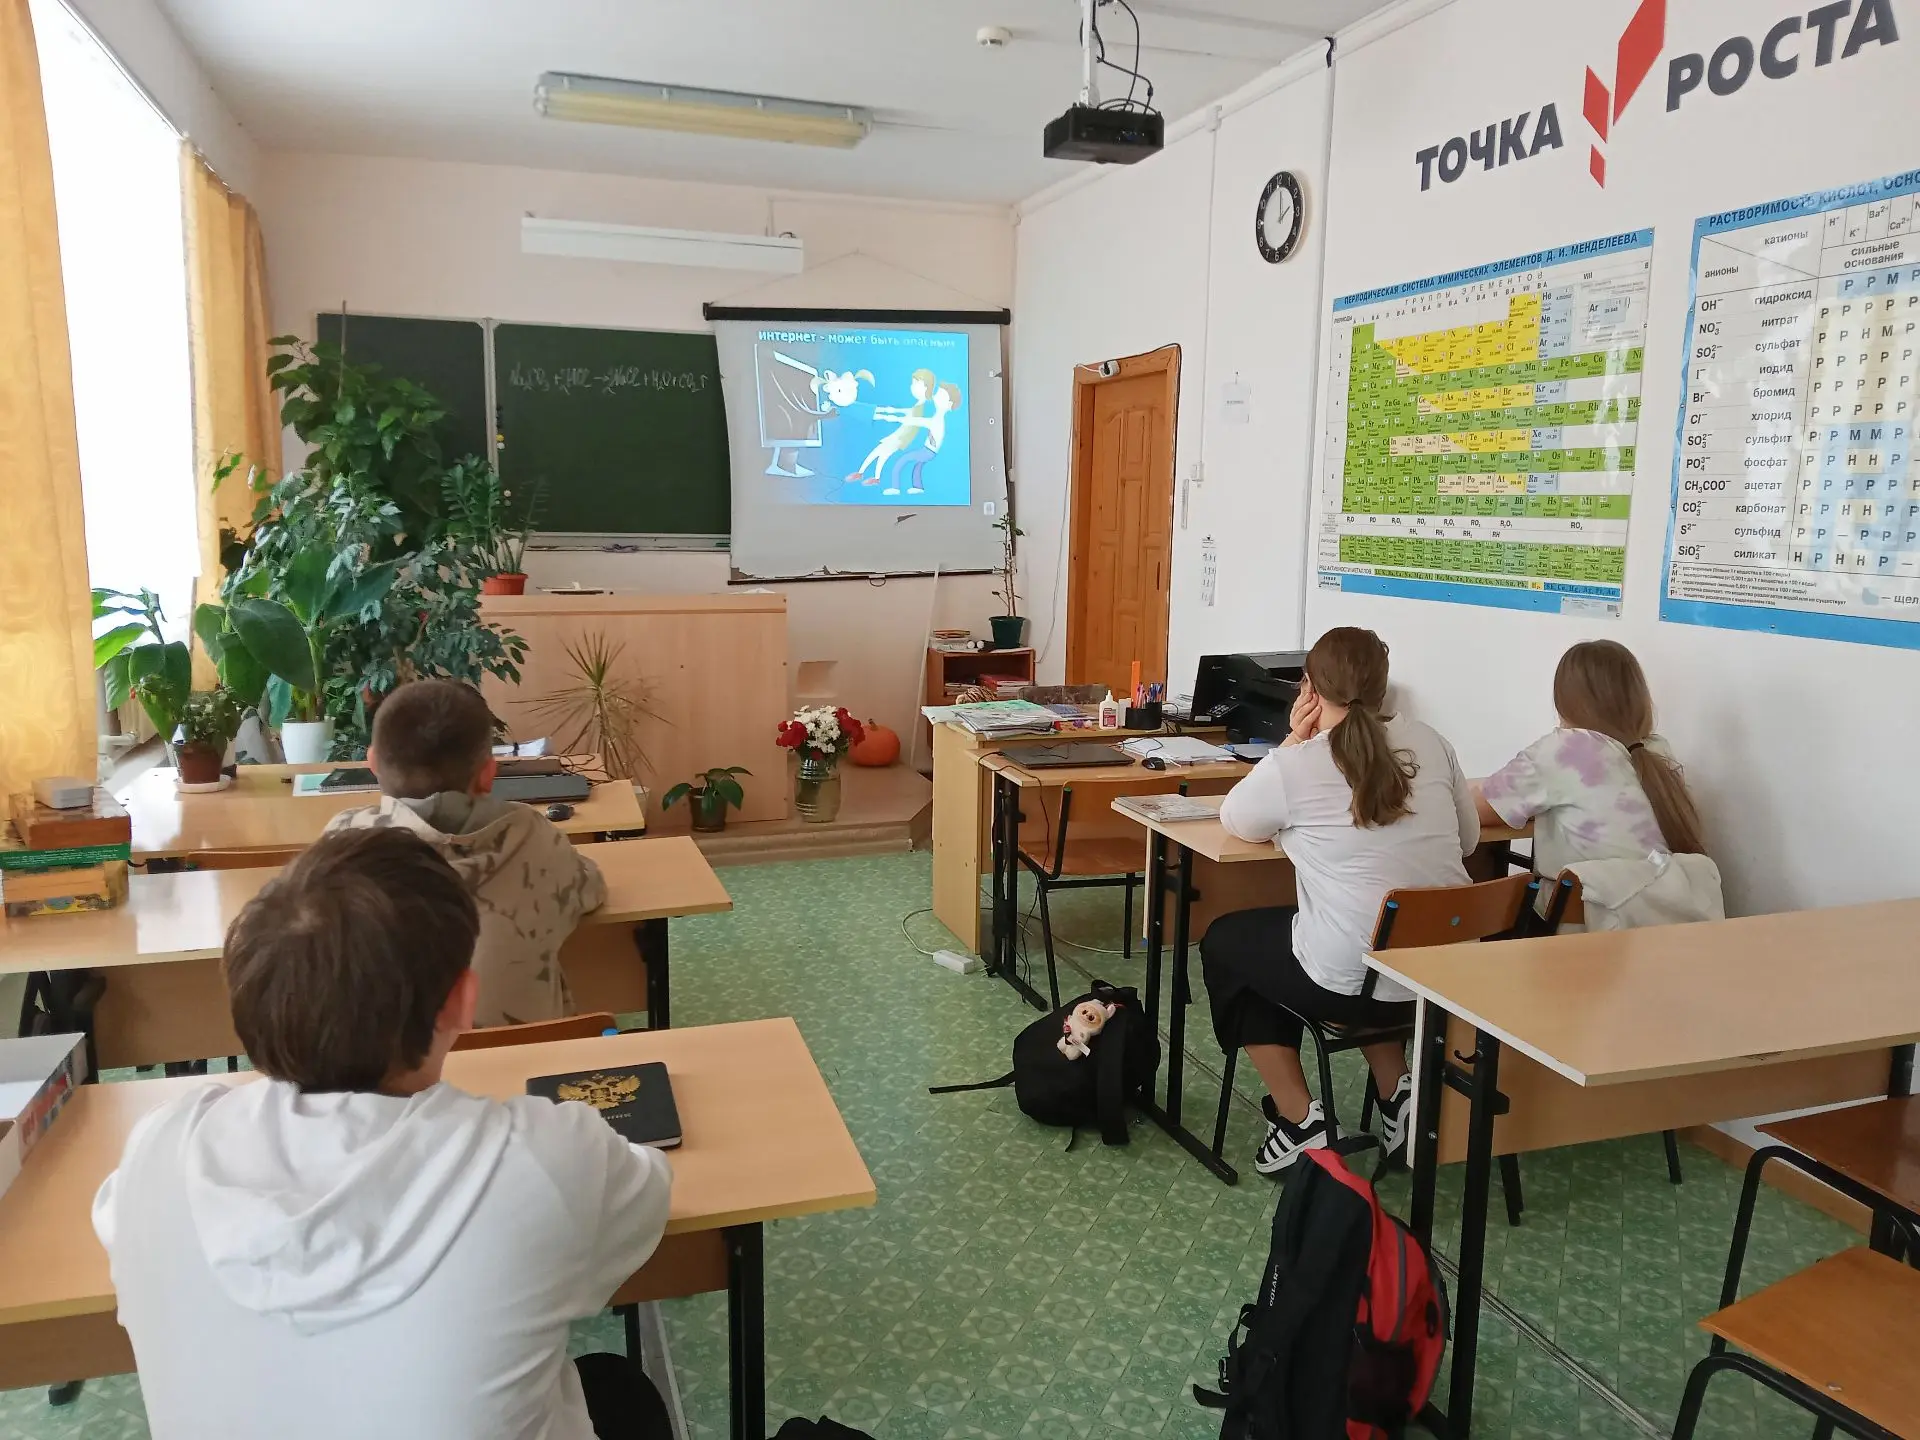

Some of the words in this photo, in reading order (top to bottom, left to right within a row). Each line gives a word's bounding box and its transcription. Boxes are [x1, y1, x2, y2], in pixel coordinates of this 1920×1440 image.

[1416, 102, 1564, 192] ТОЧКА
[1666, 0, 1899, 113] РОСТА
[1709, 193, 1815, 228] РАСТВОРИМОСТЬ
[1764, 230, 1809, 246] катионы
[1851, 241, 1900, 256] сильные
[1844, 252, 1904, 269] основания
[1344, 285, 1400, 305] ПЕРИОДИЧЕСКАЯ
[1402, 278, 1435, 293] СИСТЕМА
[1438, 266, 1490, 285] ХИМИЧЕСКИХ
[1492, 253, 1542, 273] ЭЛЕМЕНТОВ
[1570, 233, 1638, 256] МЕНДЕЛЕЕВА
[1705, 265, 1739, 278] анионы
[1755, 289, 1812, 305] гидроксид
[1761, 315, 1799, 328] нитрат
[828, 333, 867, 344] может
[1755, 339, 1801, 353] сульфат
[1760, 364, 1793, 375] иодид
[1753, 387, 1796, 399] бромид
[1751, 411, 1792, 423] хлорид
[1745, 434, 1792, 446] сульфит
[1744, 457, 1787, 469] фосфат
[1744, 481, 1782, 492] ацетат
[1735, 503, 1786, 515] карбонат
[1734, 526, 1781, 538] сульфид
[1733, 550, 1777, 561] силикат
